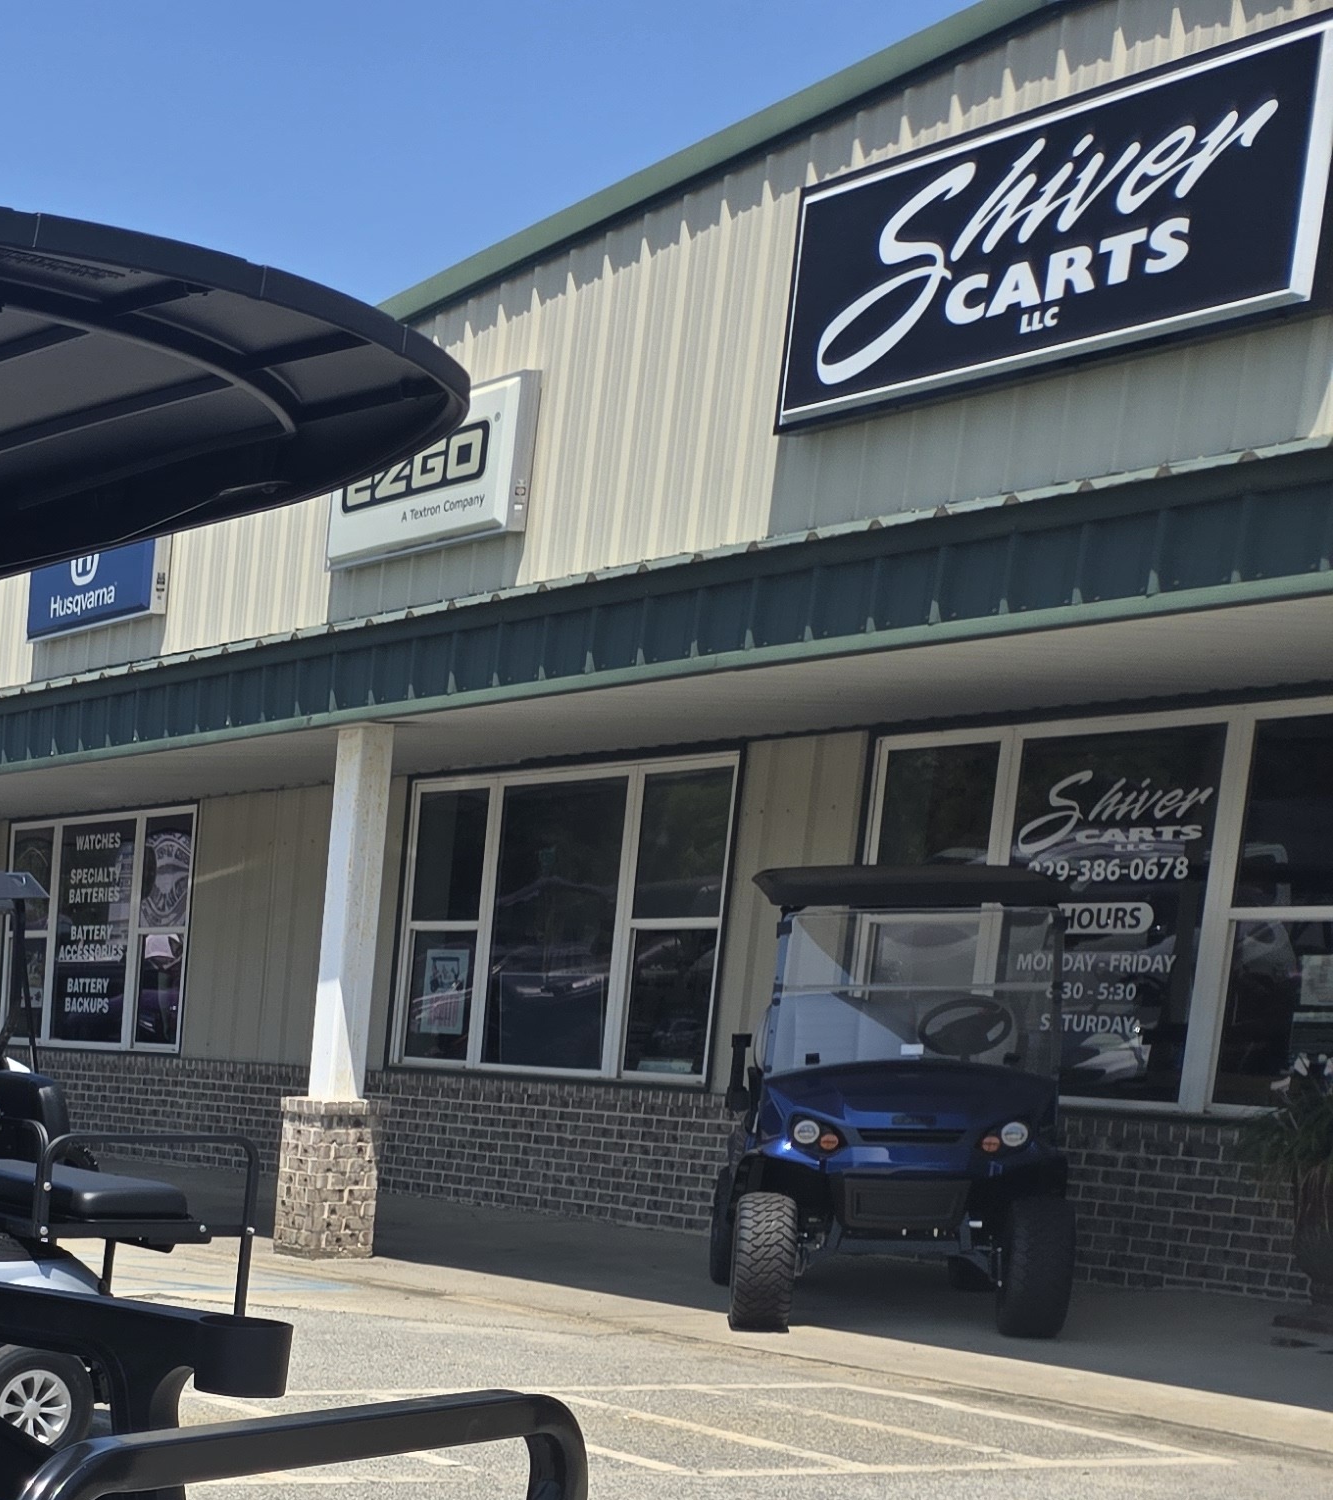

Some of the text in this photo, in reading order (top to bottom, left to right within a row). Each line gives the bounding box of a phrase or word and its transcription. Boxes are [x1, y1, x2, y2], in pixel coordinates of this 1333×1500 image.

[816, 98, 1279, 386] Shiver
[944, 216, 1191, 325] CARTS
[1019, 306, 1060, 335] LLC
[401, 493, 486, 524] A Textron Company
[50, 585, 116, 619] Husqvarna
[1017, 769, 1214, 854] Shiver
[75, 832, 121, 851] WATCHES
[1075, 824, 1203, 844] CARTS
[1114, 843, 1155, 852] LLC
[69, 866, 121, 885] SPECIALTY
[68, 886, 121, 904] BATTERIES
[1064, 906, 1142, 930] HOURS
[70, 925, 114, 941] BATTERY
[58, 944, 124, 962] ACCESSORIES
[1109, 954, 1177, 974] FRIDAY
[66, 978, 110, 994] BATTERY
[1097, 983, 1137, 1001] 5:30
[64, 997, 110, 1014] BACKUPS
[1039, 1013, 1135, 1034] STURDAY
